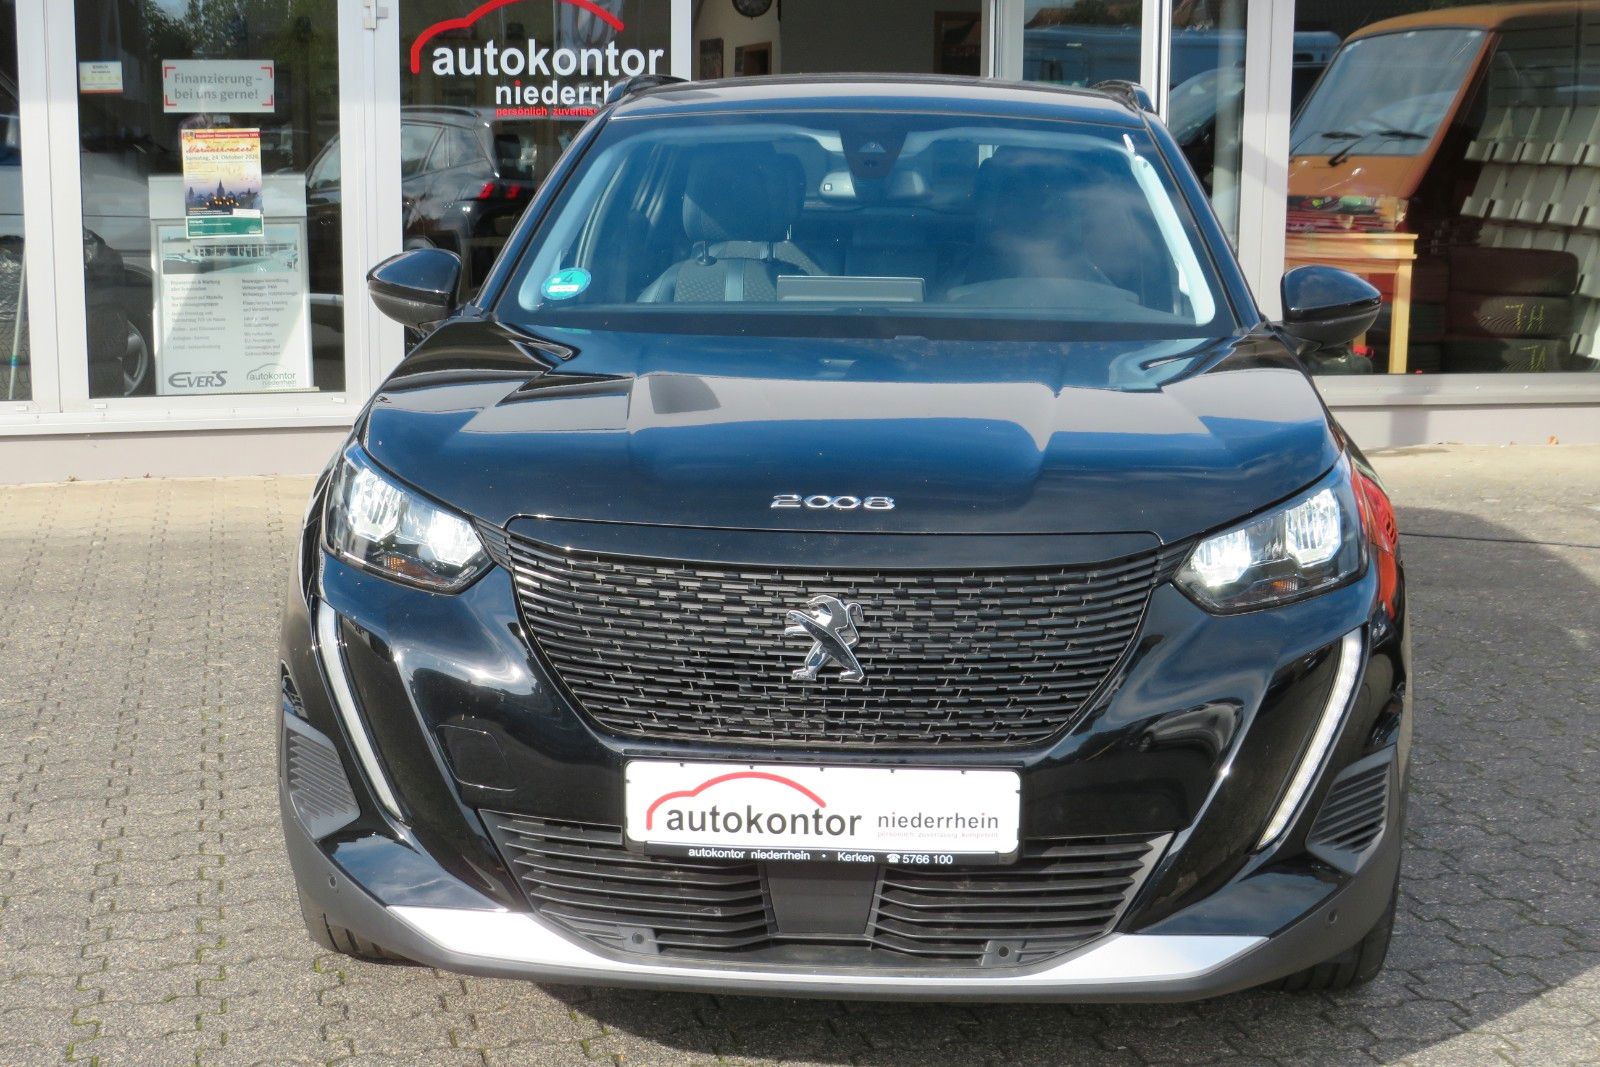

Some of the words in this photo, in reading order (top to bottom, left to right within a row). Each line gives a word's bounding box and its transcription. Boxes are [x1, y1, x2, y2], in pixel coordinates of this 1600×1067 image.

[432, 38, 664, 76] autokontor
[174, 73, 253, 86] Finanzierung
[174, 88, 193, 99] bei
[196, 91, 217, 100] uns
[219, 89, 259, 102] gerne!
[496, 80, 613, 104] niederrh
[249, 372, 297, 381] autokontor
[770, 493, 896, 510] 2008
[666, 804, 862, 837] autokontor
[877, 811, 999, 829] niederrhein
[688, 847, 746, 860] autokontor
[750, 848, 811, 861] niederrhein
[837, 851, 876, 864] Kerken
[902, 853, 930, 865] 5766
[933, 853, 954, 865] 100
